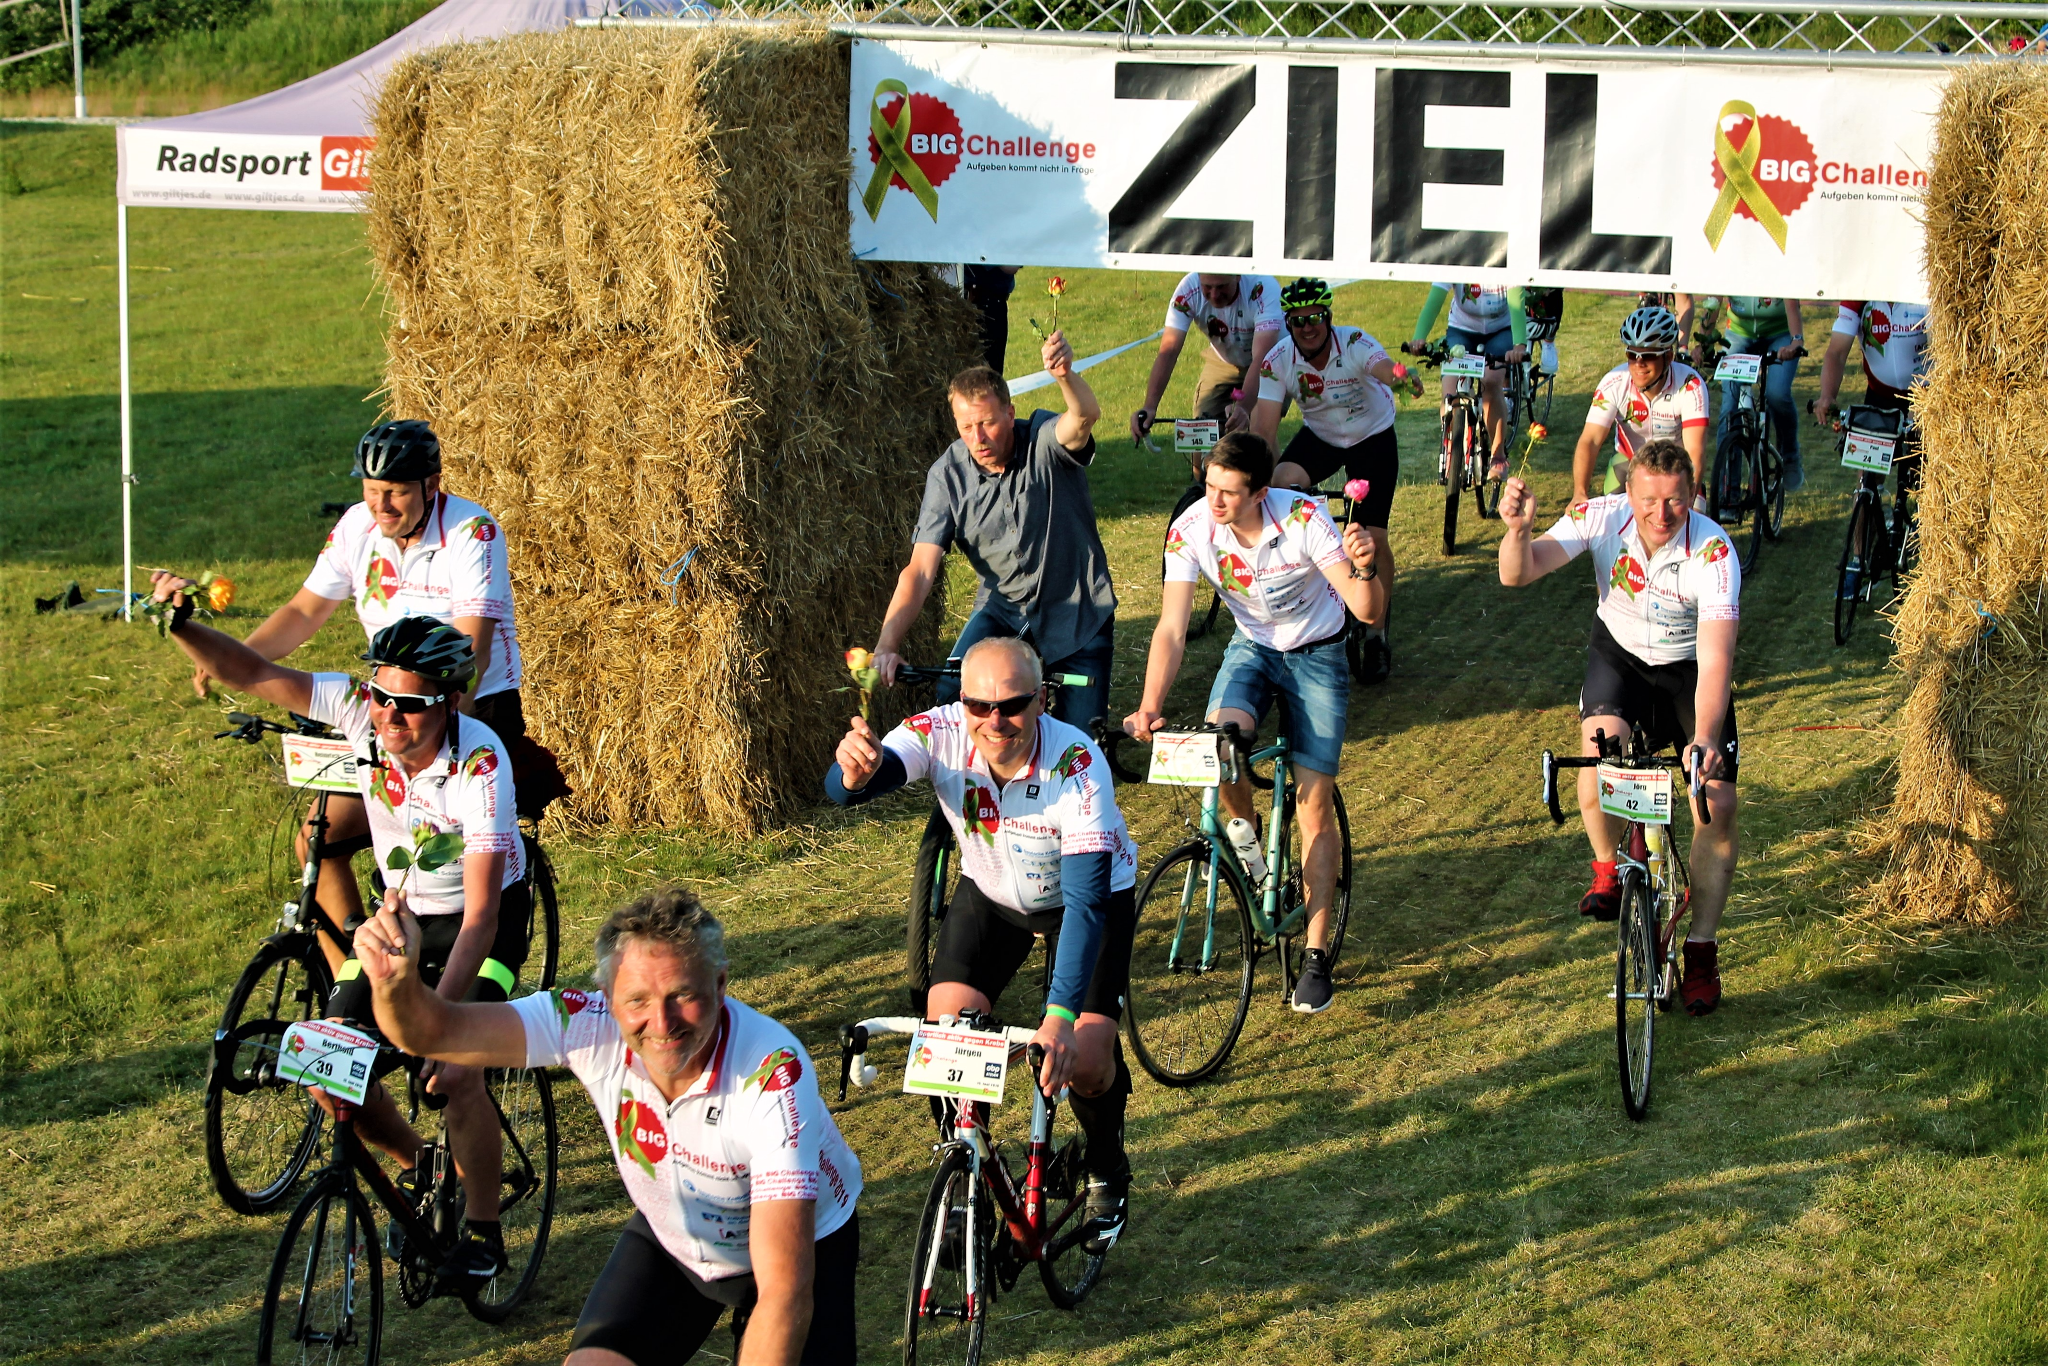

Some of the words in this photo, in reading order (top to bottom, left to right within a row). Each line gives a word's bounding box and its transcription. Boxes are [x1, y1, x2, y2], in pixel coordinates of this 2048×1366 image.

[911, 134, 957, 155] BIG
[967, 134, 1096, 163] Challenge
[157, 145, 312, 182] Radsport
[966, 162, 1006, 172] Aufgeben
[1008, 163, 1037, 172] kommt
[1039, 164, 1060, 173] nicht
[1061, 164, 1069, 173] in
[1071, 165, 1094, 175] Frage
[1108, 62, 1673, 276] ZIEL
[1760, 158, 1811, 183] BIG
[1820, 191, 1864, 202] Aufgeben
[1867, 192, 1898, 202] kommt
[1872, 325, 1890, 333] BIG
[1862, 454, 1872, 463] 24
[380, 575, 398, 586] BIG
[400, 580, 450, 595] Challenge
[1627, 570, 1645, 585] BIG
[911, 717, 931, 727] BIG
[1626, 799, 1639, 811] 42
[979, 808, 998, 824] BI
[562, 991, 586, 1004] BIG
[316, 1059, 333, 1077] 39
[947, 1068, 964, 1082] 37
[635, 1126, 667, 1150] BIG
[672, 1142, 748, 1175] Challenge
